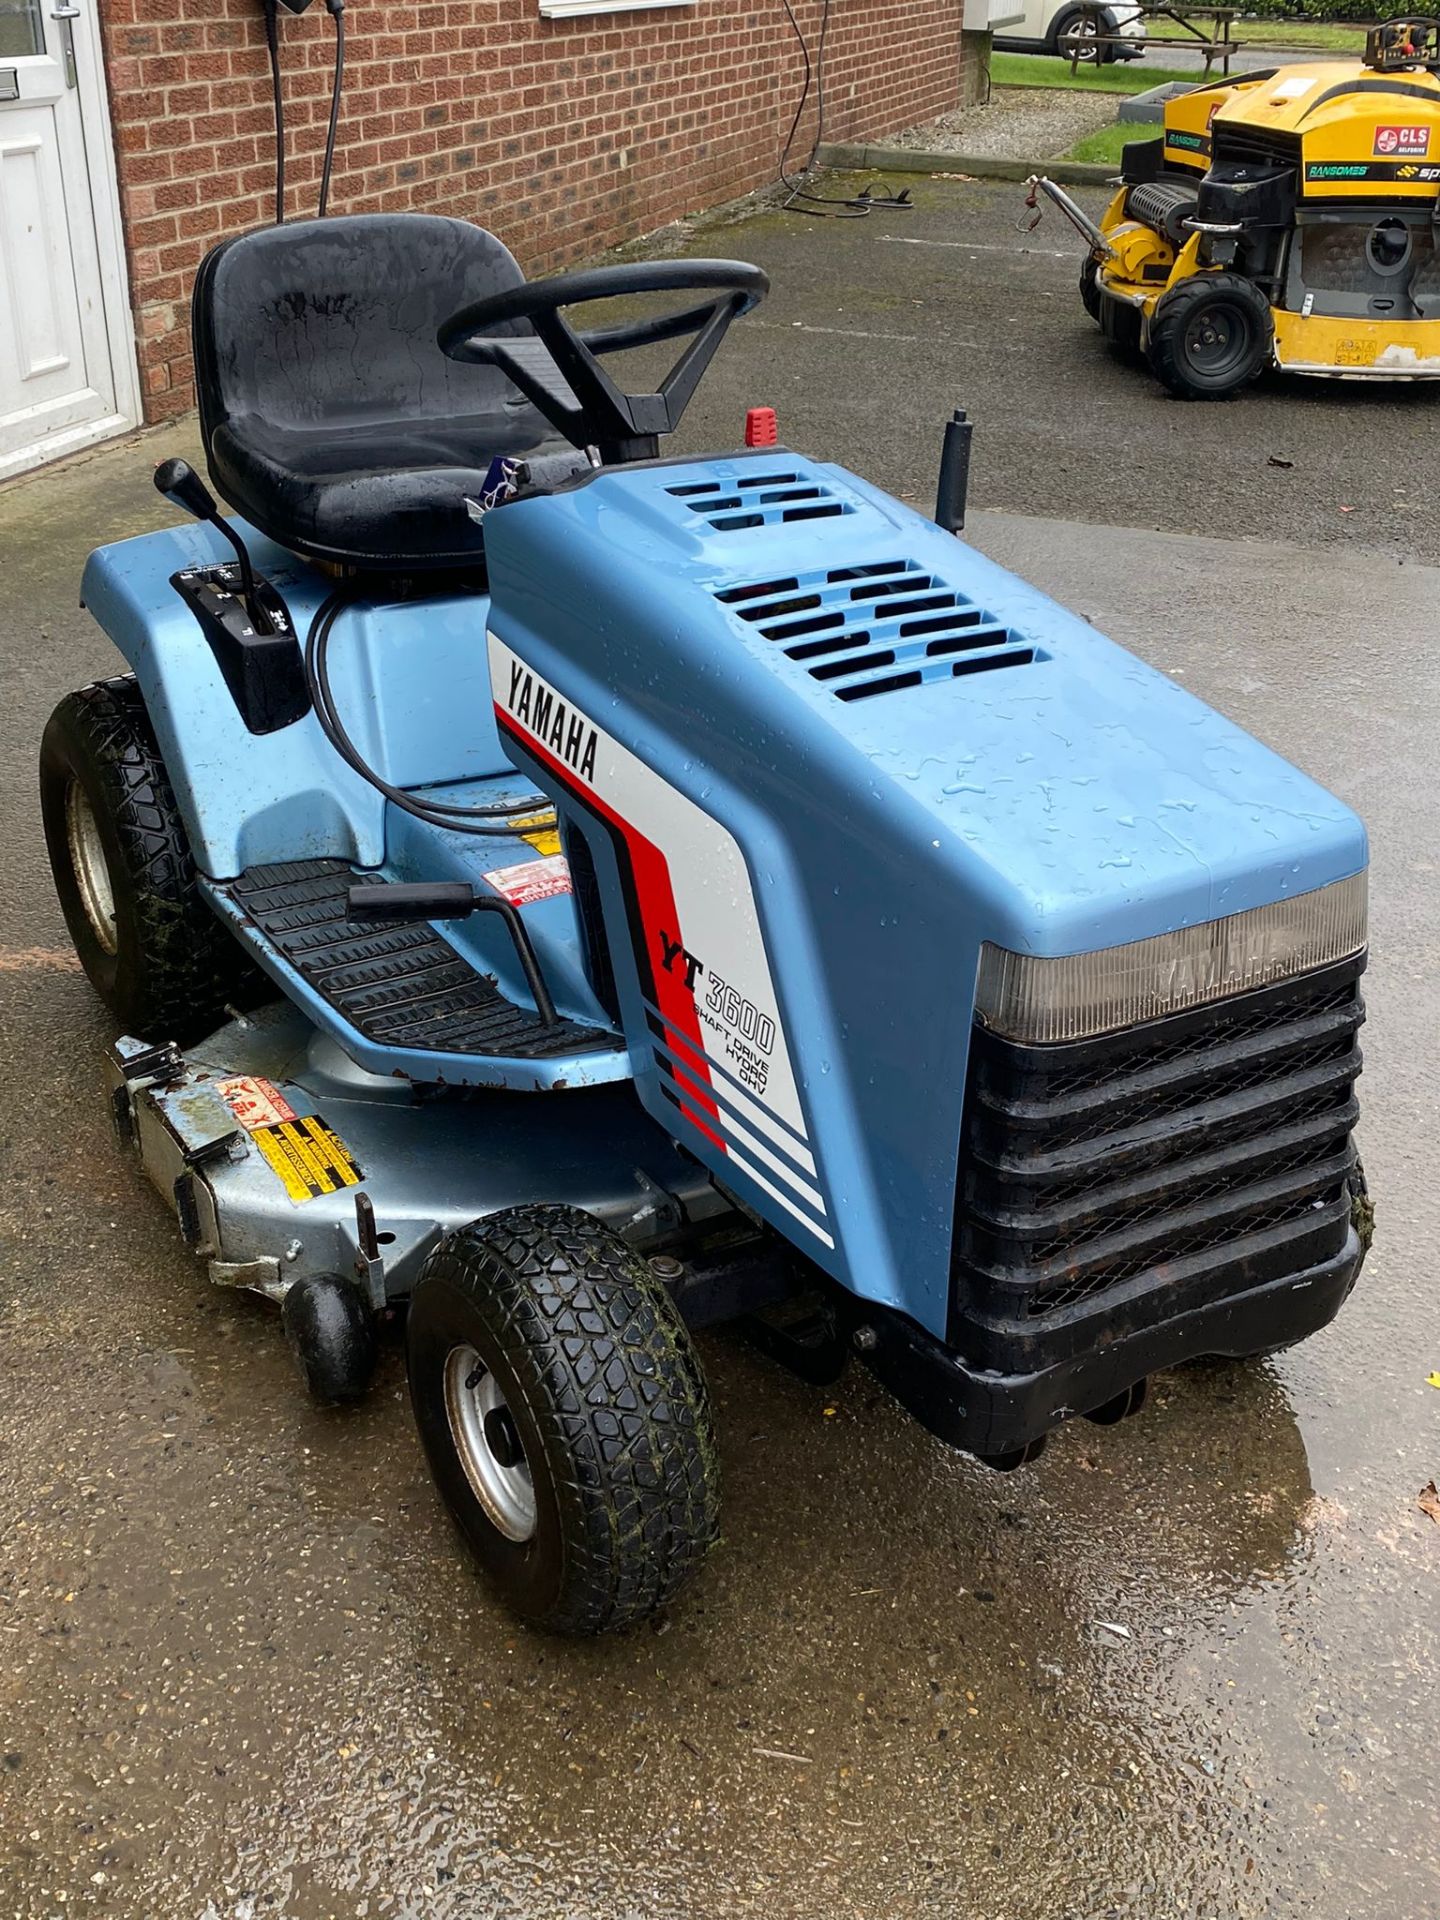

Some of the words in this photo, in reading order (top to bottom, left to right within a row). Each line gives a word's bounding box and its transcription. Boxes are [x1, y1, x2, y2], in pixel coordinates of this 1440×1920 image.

[1400, 129, 1427, 143] CLS
[1309, 166, 1367, 176] RANSOMES
[508, 660, 598, 783] YAMAHA
[659, 929, 704, 993] YT
[706, 970, 776, 1056] 3600
[693, 1004, 731, 1040] SHAFT
[733, 1038, 769, 1072] DRIVE
[726, 1044, 768, 1086] HYDRO
[739, 1068, 766, 1095] OHV
[279, 1139, 317, 1186] AVERTISSEMENT
[308, 1140, 333, 1170] WARNING
